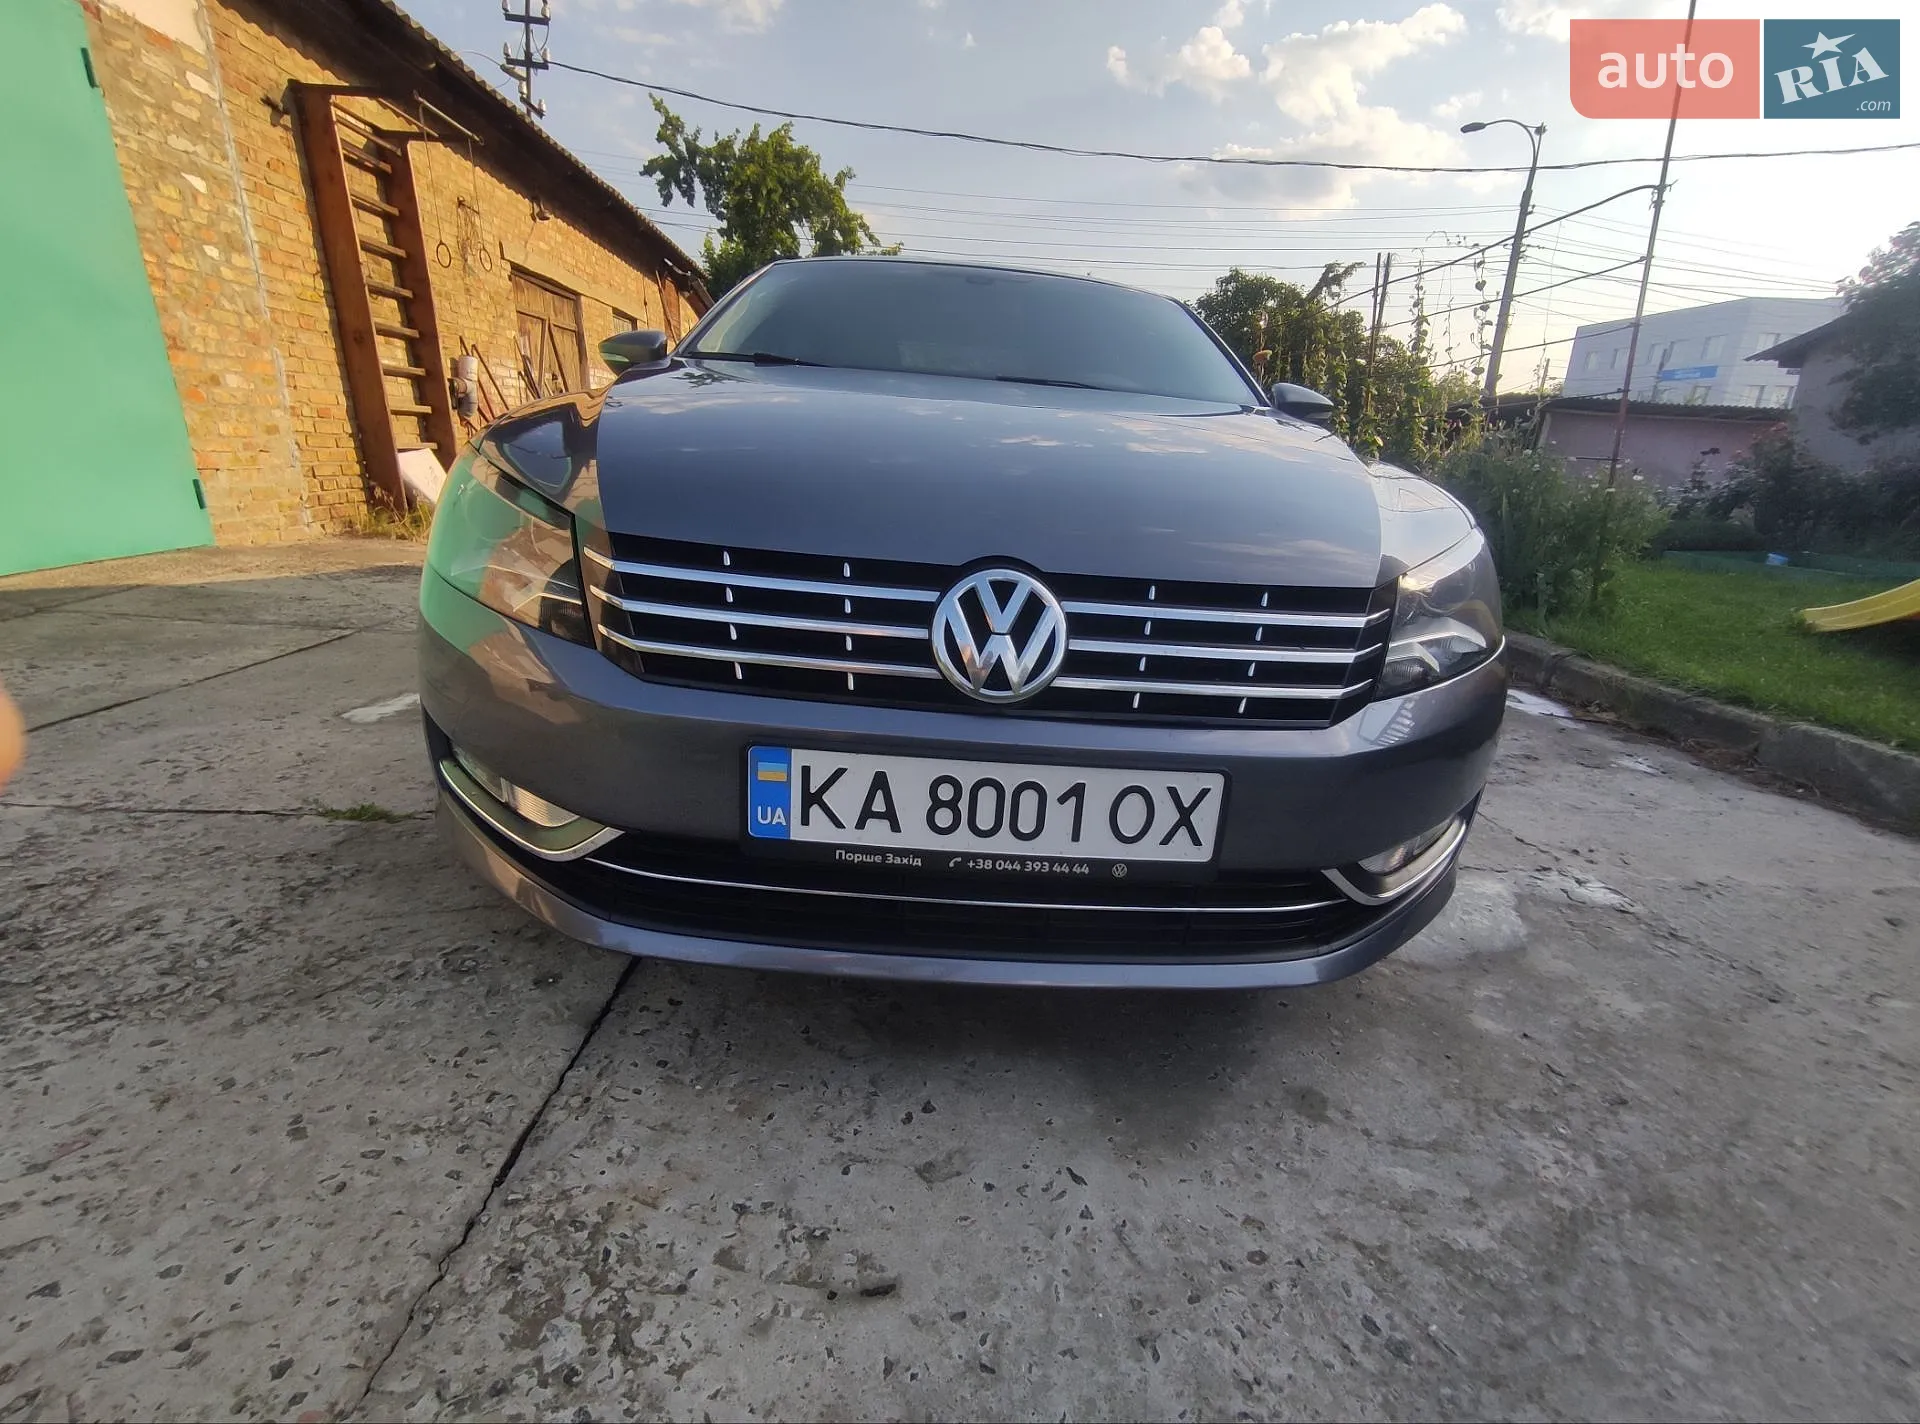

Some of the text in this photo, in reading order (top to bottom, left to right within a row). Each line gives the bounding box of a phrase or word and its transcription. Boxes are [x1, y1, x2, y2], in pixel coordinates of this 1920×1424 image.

[757, 805, 787, 826] UA
[800, 765, 1212, 847] KA 8001 OX
[835, 849, 922, 867] Порше Захід
[967, 858, 1090, 875] +38 044 393 44 44
